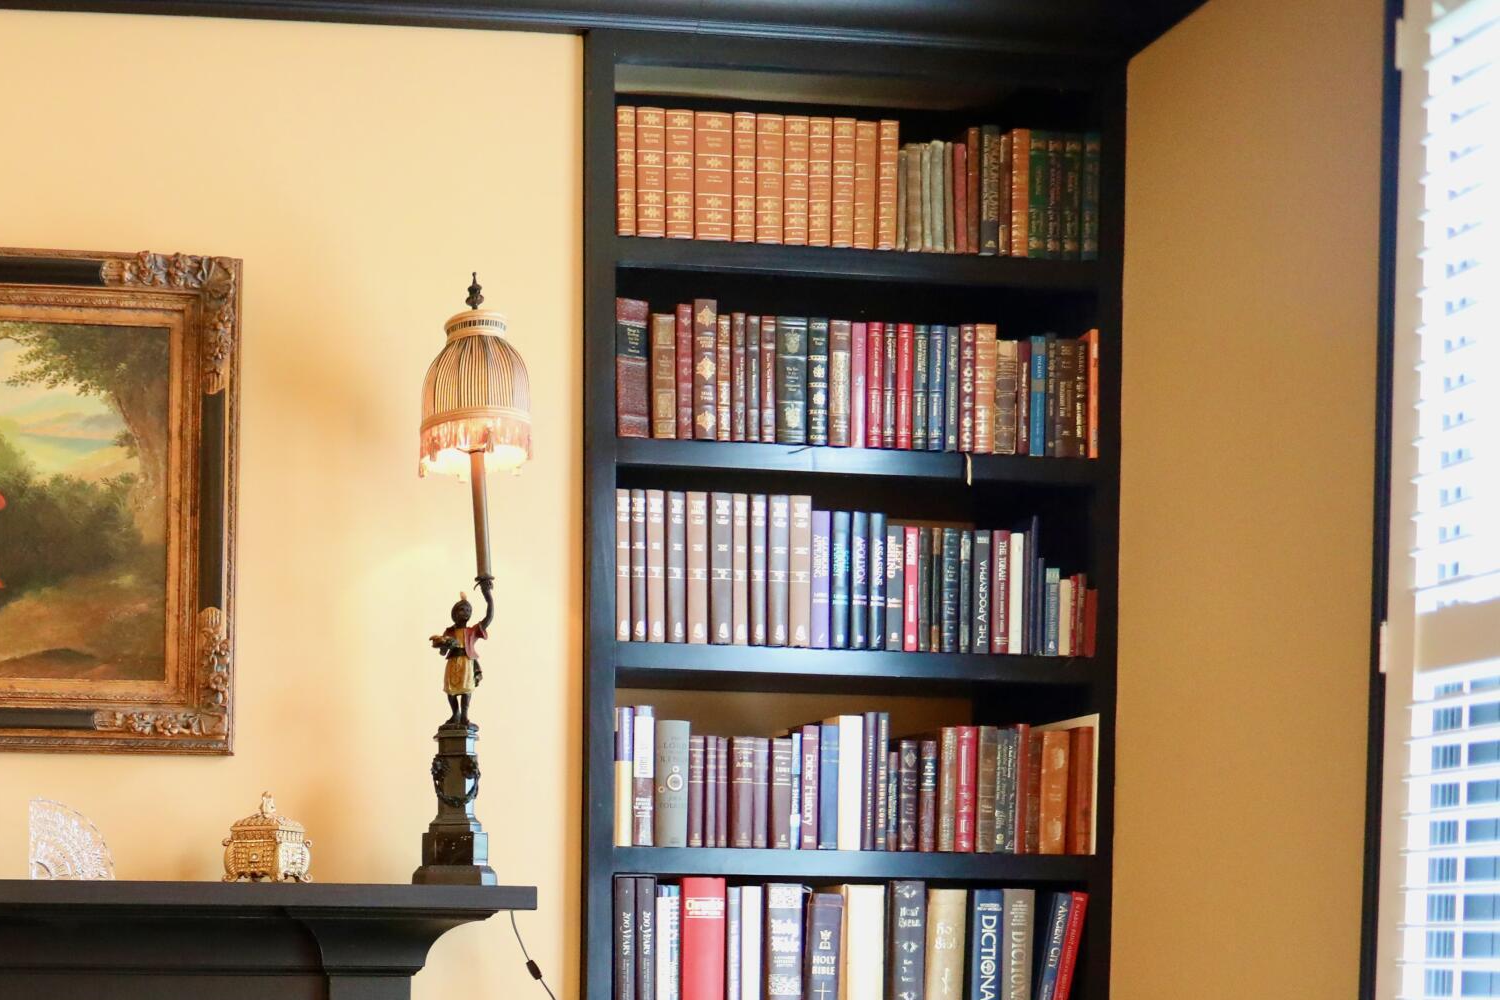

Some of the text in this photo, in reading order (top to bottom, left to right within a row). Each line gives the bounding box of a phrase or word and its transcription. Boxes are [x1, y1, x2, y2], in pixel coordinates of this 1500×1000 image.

[856, 536, 866, 585] APOLLYON
[887, 535, 896, 579] BEHIND
[895, 543, 903, 571] LEFT
[999, 541, 1007, 555] THE
[873, 538, 883, 586] ASSASSINS
[999, 556, 1007, 581] TORAH
[977, 560, 988, 647] THE APOCRYPHA
[879, 766, 887, 781] THE
[802, 753, 816, 826] Bible History
[879, 783, 887, 806] BIBLE
[878, 808, 886, 828] CODE
[622, 911, 631, 929] 200
[642, 911, 651, 929] 200
[619, 928, 632, 956] YEARS
[639, 928, 652, 956] YEARS
[1048, 905, 1068, 970] ANCIENT CITY
[811, 966, 836, 976] BIBLE
[812, 955, 836, 964] HOLY
